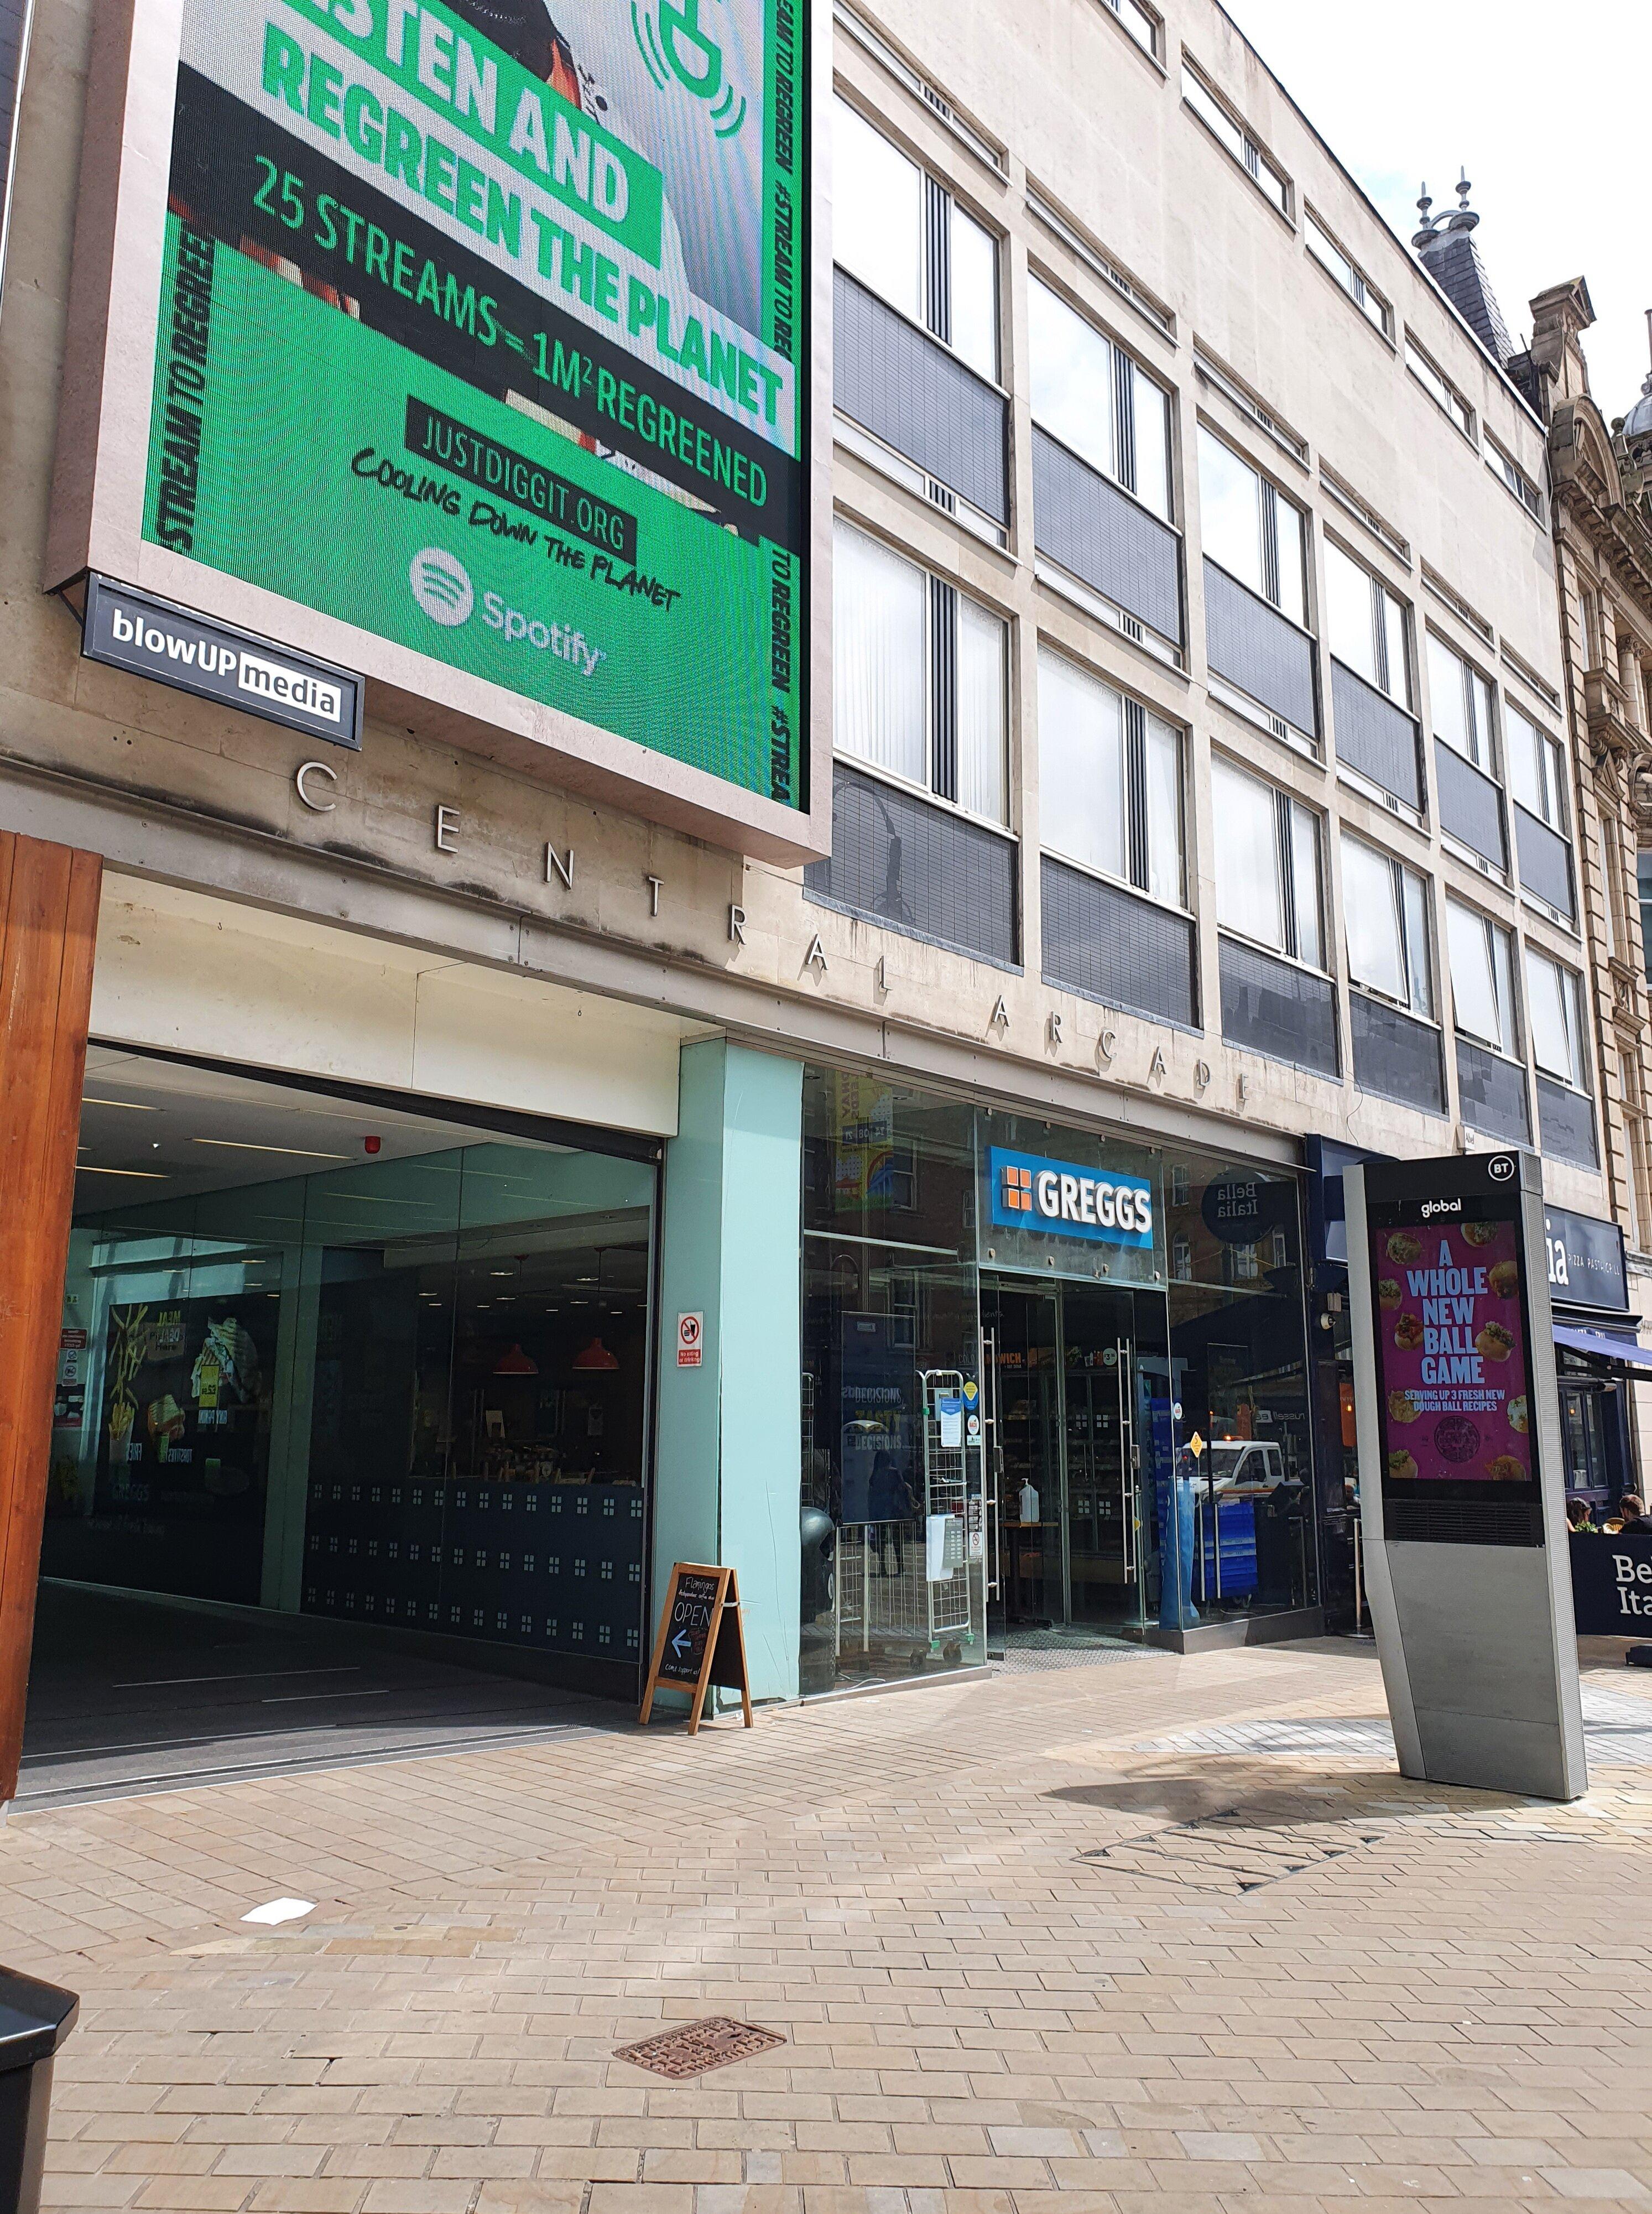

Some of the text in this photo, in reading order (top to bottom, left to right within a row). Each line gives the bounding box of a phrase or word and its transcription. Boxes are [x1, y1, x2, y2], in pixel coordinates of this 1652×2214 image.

[303, 0, 629, 222] STEN AND
[262, 22, 783, 425] REGREEN THE PLANET
[252, 155, 304, 229] 25
[315, 194, 498, 346] STREAMS
[597, 368, 767, 507] REGREENED
[423, 416, 624, 550] JUSTDIGGIT.ORG
[351, 447, 681, 612] COOLING DOWN THE PLANET
[482, 591, 606, 676] Spotify
[296, 761, 1249, 1101] CENTRAL ARCADE
[1493, 1163, 1509, 1174] BT
[1035, 1169, 1152, 1234] GREGGS
[1421, 1197, 1462, 1218] global
[1439, 1239, 1453, 1267] A
[1567, 1253, 1585, 1267] PIZZA
[1406, 1267, 1488, 1297] WHOLE
[1422, 1296, 1474, 1326] NEW
[1424, 1326, 1479, 1355] BALL
[1421, 1356, 1486, 1384] GAME
[1404, 1389, 1505, 1400] SERVING UP 3 FRESH NEW
[1413, 1400, 1498, 1411] DOUGH BALL RECIPES
[1612, 1554, 1652, 1584] Be
[674, 1602, 715, 1627] OPEN
